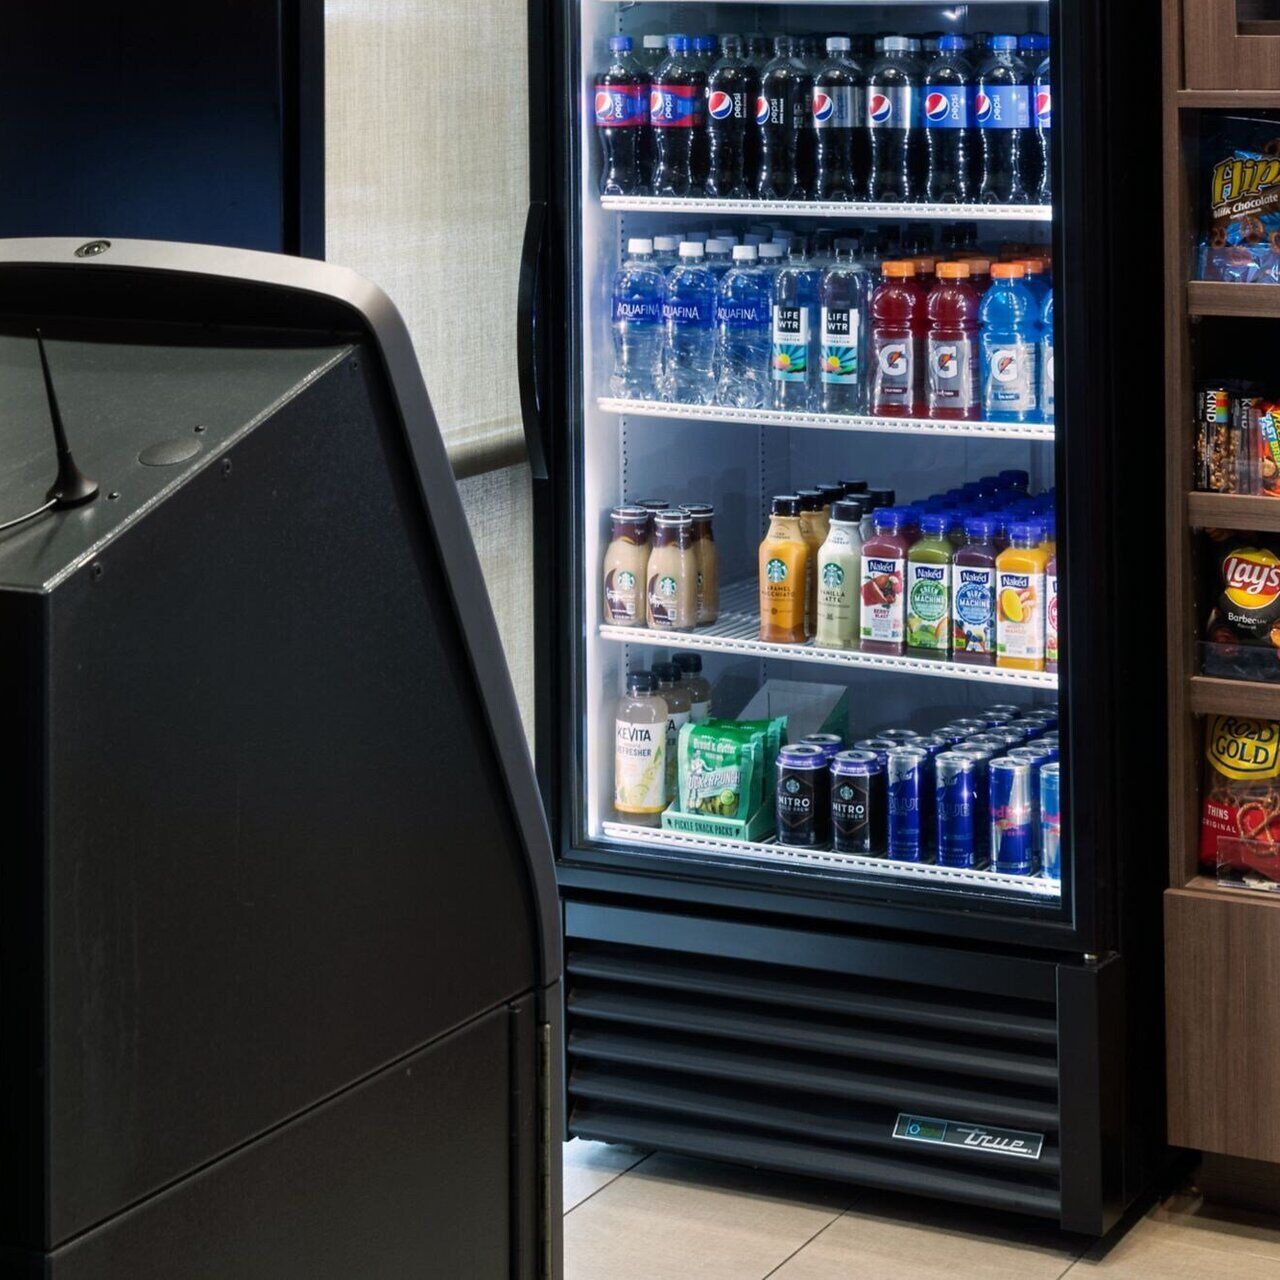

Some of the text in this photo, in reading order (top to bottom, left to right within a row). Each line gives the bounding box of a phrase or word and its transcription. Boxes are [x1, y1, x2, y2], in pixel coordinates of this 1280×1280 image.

[614, 94, 623, 119] pepsi
[664, 94, 672, 119] pepsi
[733, 93, 742, 118] pepsi
[770, 98, 778, 124] pepsi
[951, 94, 959, 120] pepsi
[993, 94, 1001, 120] pepsi
[1214, 204, 1232, 219] Milk
[1232, 193, 1279, 213] Chocolate
[778, 310, 799, 320] LIFE
[778, 321, 800, 329] WTR
[827, 312, 848, 321] LIFE
[827, 322, 849, 331] WTR
[879, 343, 907, 376] G
[934, 346, 958, 379] G
[991, 349, 1018, 382] G
[1206, 390, 1217, 423] KIND
[1215, 736, 1270, 765] GOLD
[688, 769, 741, 790] UCKERPUNCH
[778, 796, 810, 807] NITRO
[832, 802, 864, 814] NITRO
[1207, 804, 1229, 820] THINS
[673, 820, 733, 836] PICKLE SNACK PACKS
[1202, 817, 1237, 834] ORIGINAL
